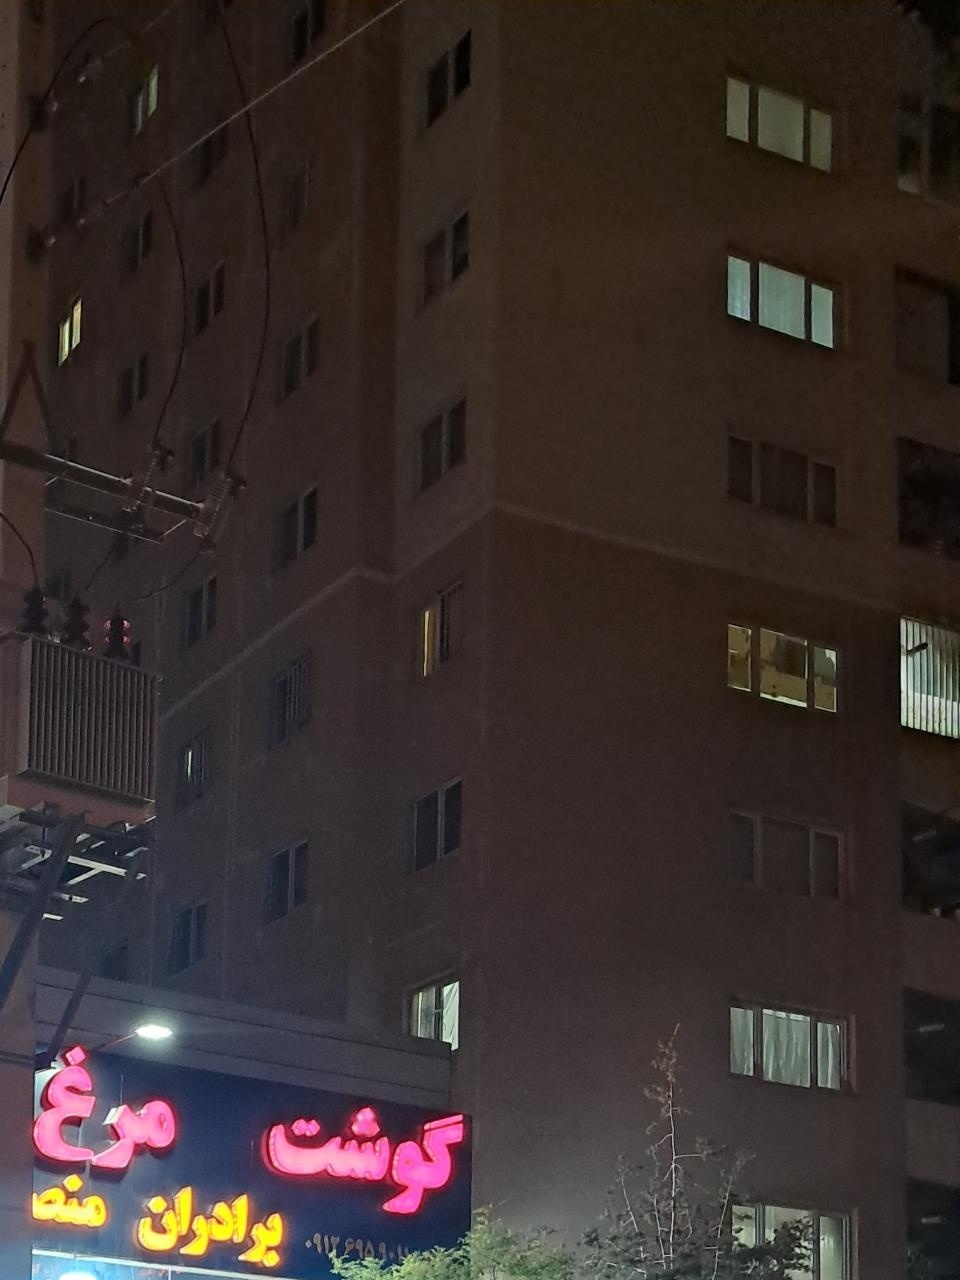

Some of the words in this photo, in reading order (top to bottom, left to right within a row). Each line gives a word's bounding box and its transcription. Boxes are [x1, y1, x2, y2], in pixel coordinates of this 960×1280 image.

[33, 1045, 176, 1169] مرغ
[266, 1105, 465, 1214] گوشت
[137, 1185, 283, 1268] برادران
